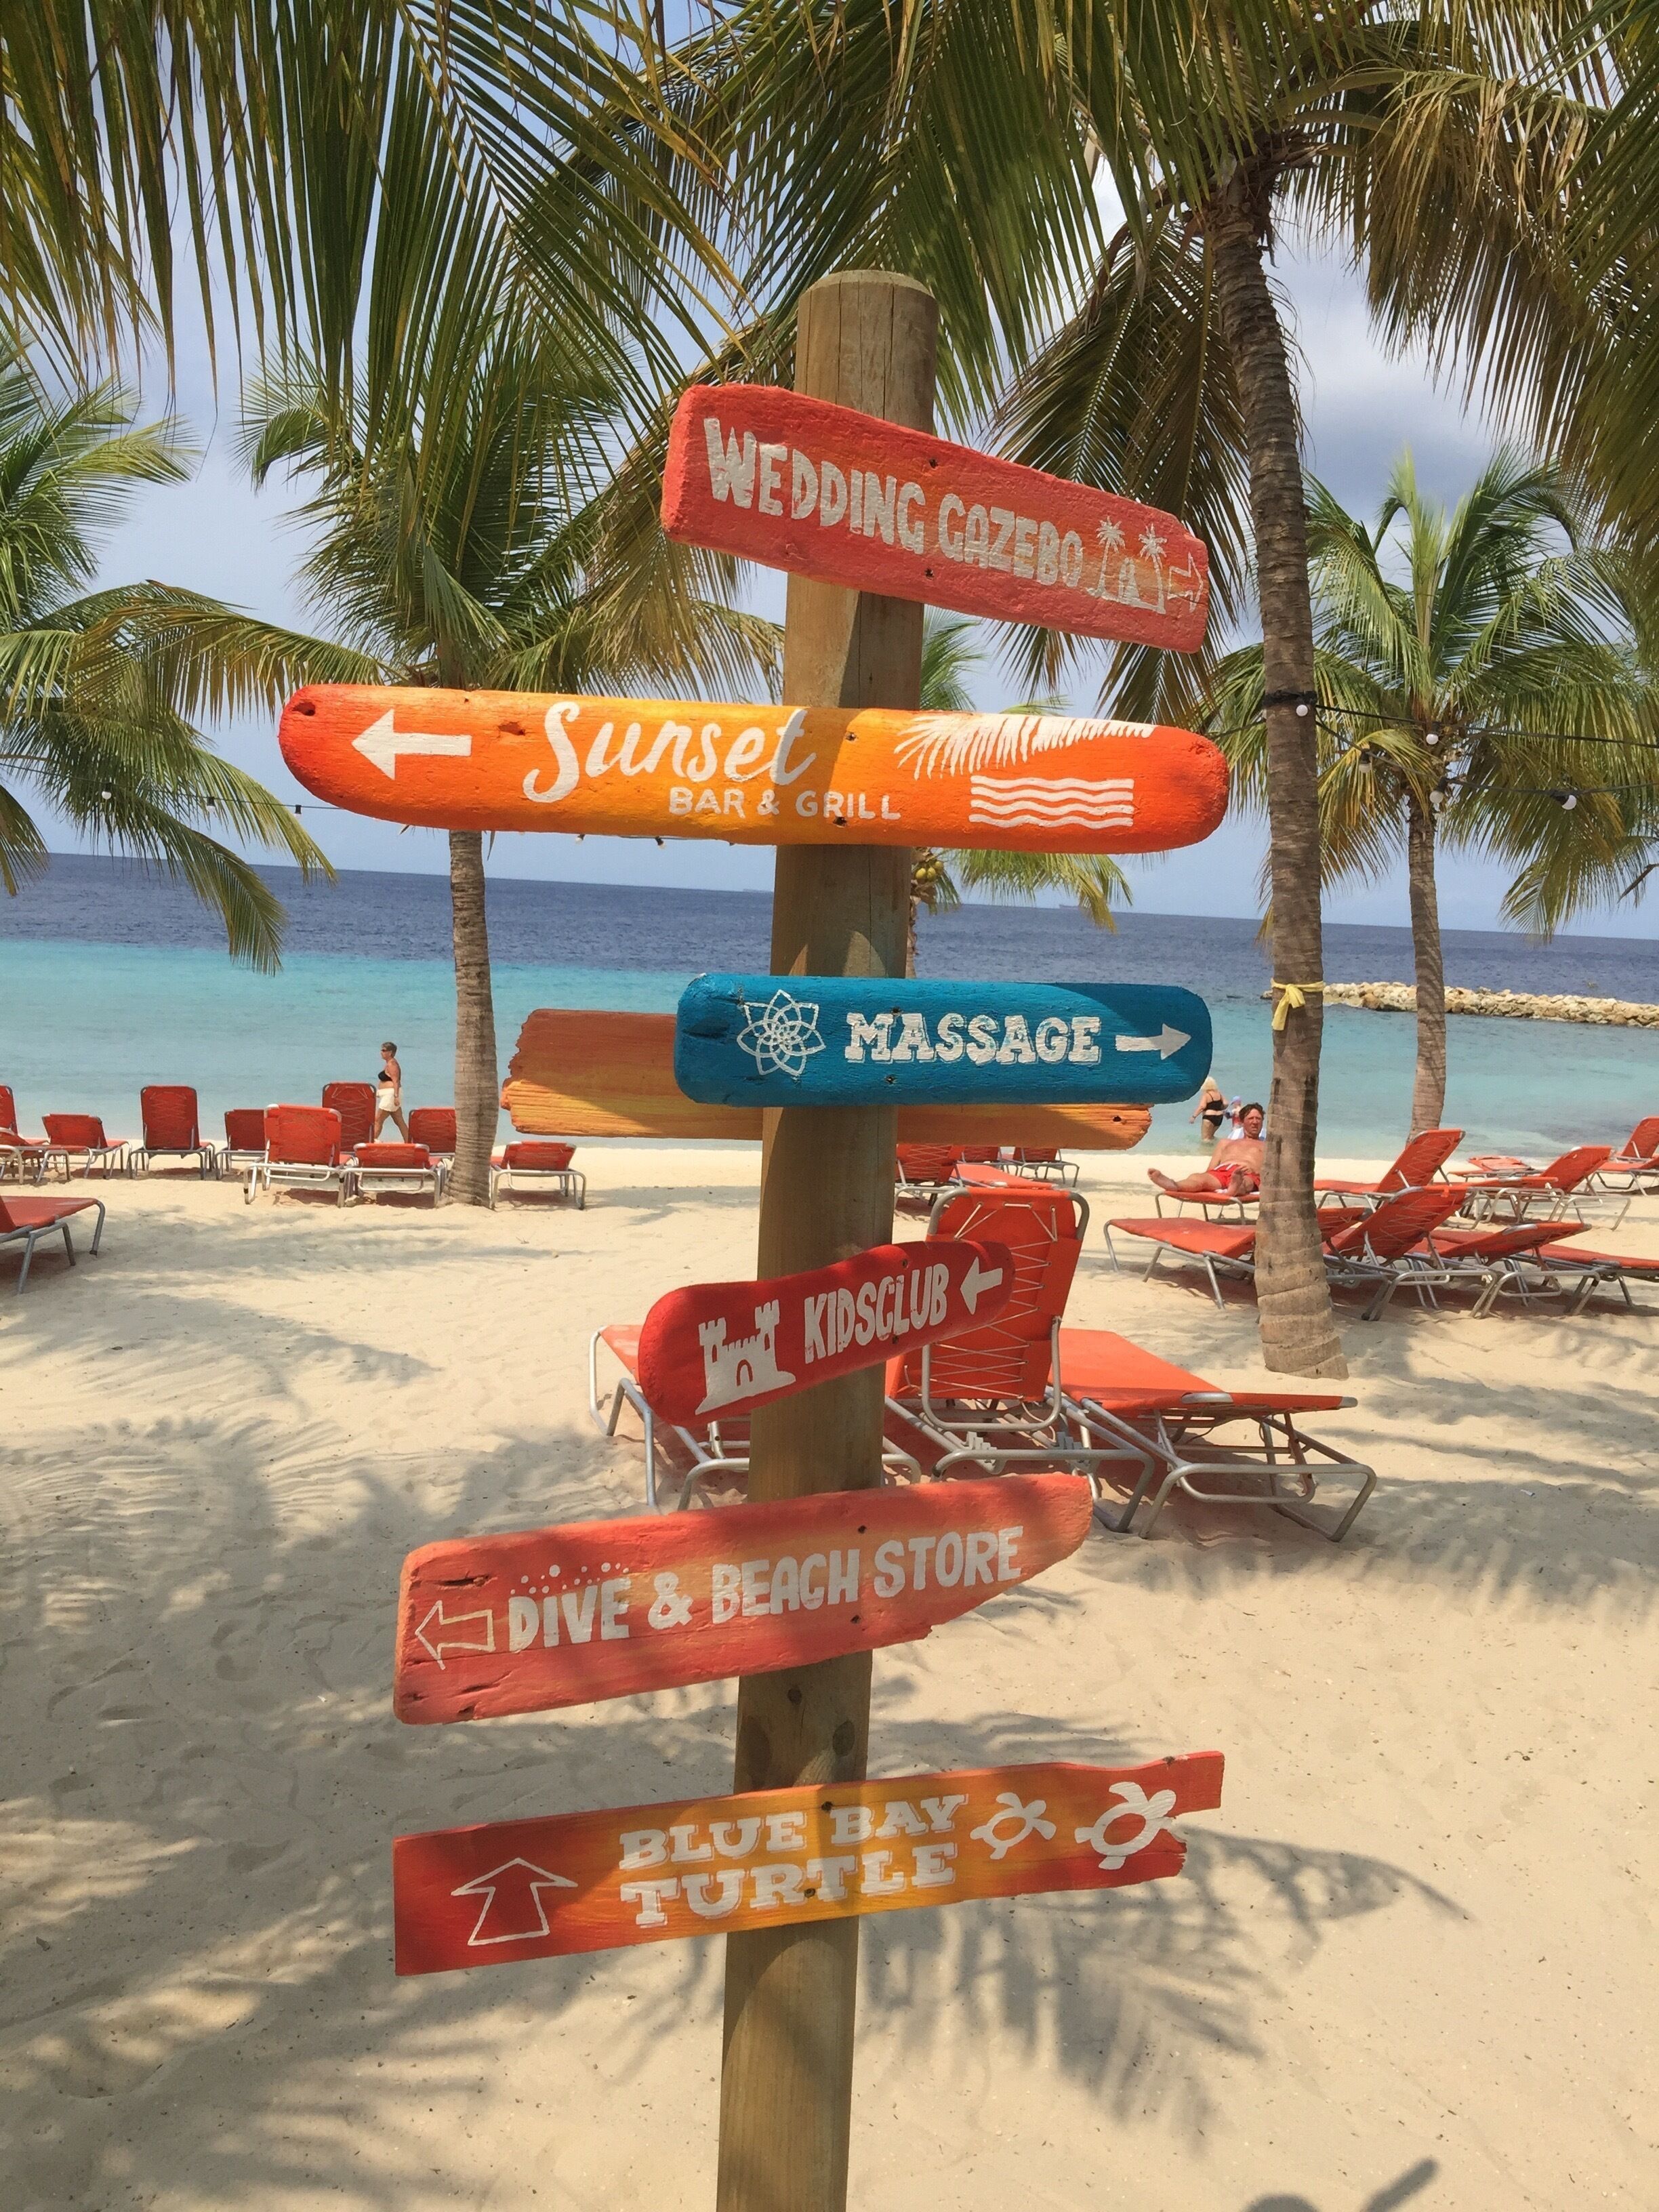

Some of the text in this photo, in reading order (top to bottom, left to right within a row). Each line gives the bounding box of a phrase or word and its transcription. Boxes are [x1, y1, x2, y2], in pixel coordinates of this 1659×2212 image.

[703, 417, 1082, 588] WEDDING GAZEBO
[523, 701, 817, 803] Sunset
[669, 786, 901, 820] BAR & GRILL
[845, 1012, 1103, 1065] MASSAGE
[804, 1263, 949, 1364] KIDSCLUB
[508, 1526, 1025, 1652] DIVE & BEACH STORE
[619, 1793, 970, 1870] BLUE BAY
[619, 1843, 957, 1929] TURTLE
